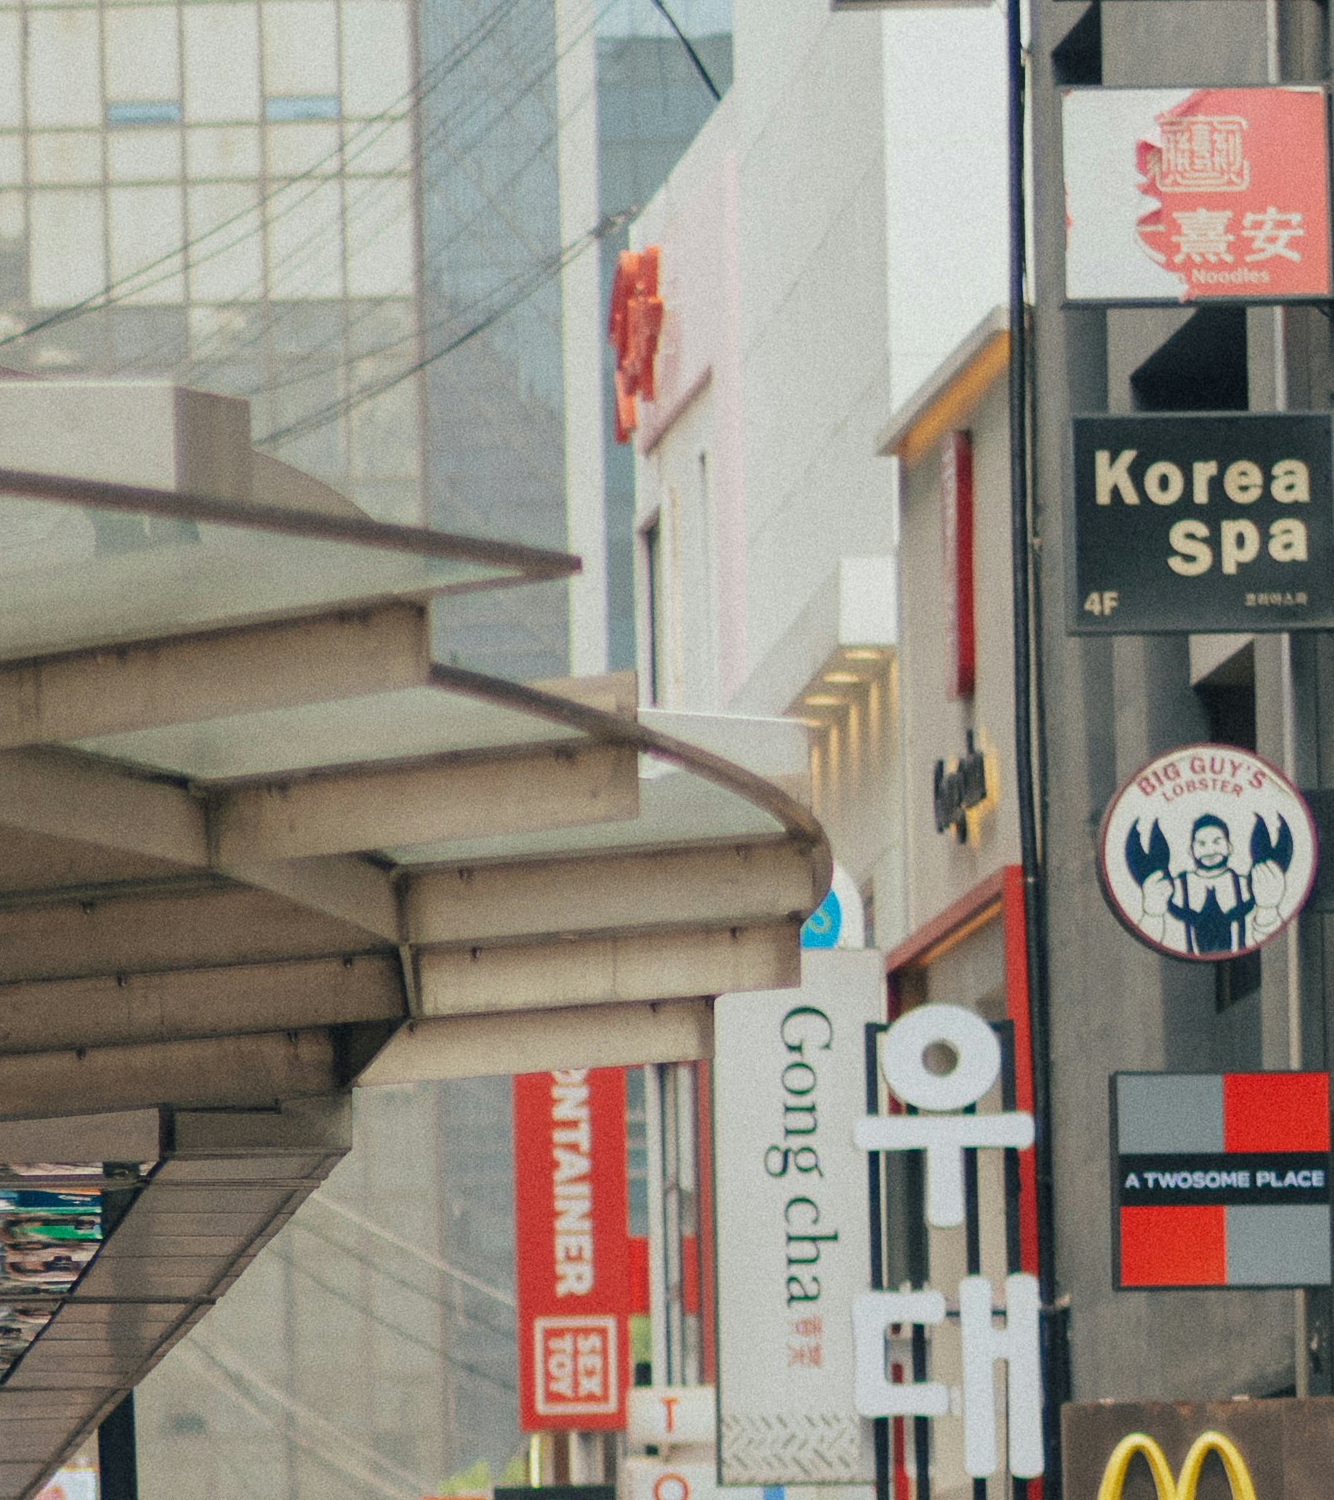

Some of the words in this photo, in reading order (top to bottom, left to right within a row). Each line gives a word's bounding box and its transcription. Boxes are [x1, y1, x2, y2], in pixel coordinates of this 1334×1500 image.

[1191, 266, 1270, 284] Noodles
[1093, 449, 1312, 506] Korea
[1083, 591, 1119, 617] 4F
[1135, 761, 1181, 797] BIG
[1188, 756, 1267, 790] GUY'S
[1162, 778, 1243, 801] LOBSTER
[765, 1005, 834, 1178] Gong
[1124, 1172, 1142, 1189] A
[1144, 1171, 1251, 1189] TWOSOME
[1256, 1169, 1325, 1188] PLACE
[783, 1196, 839, 1308] cha
